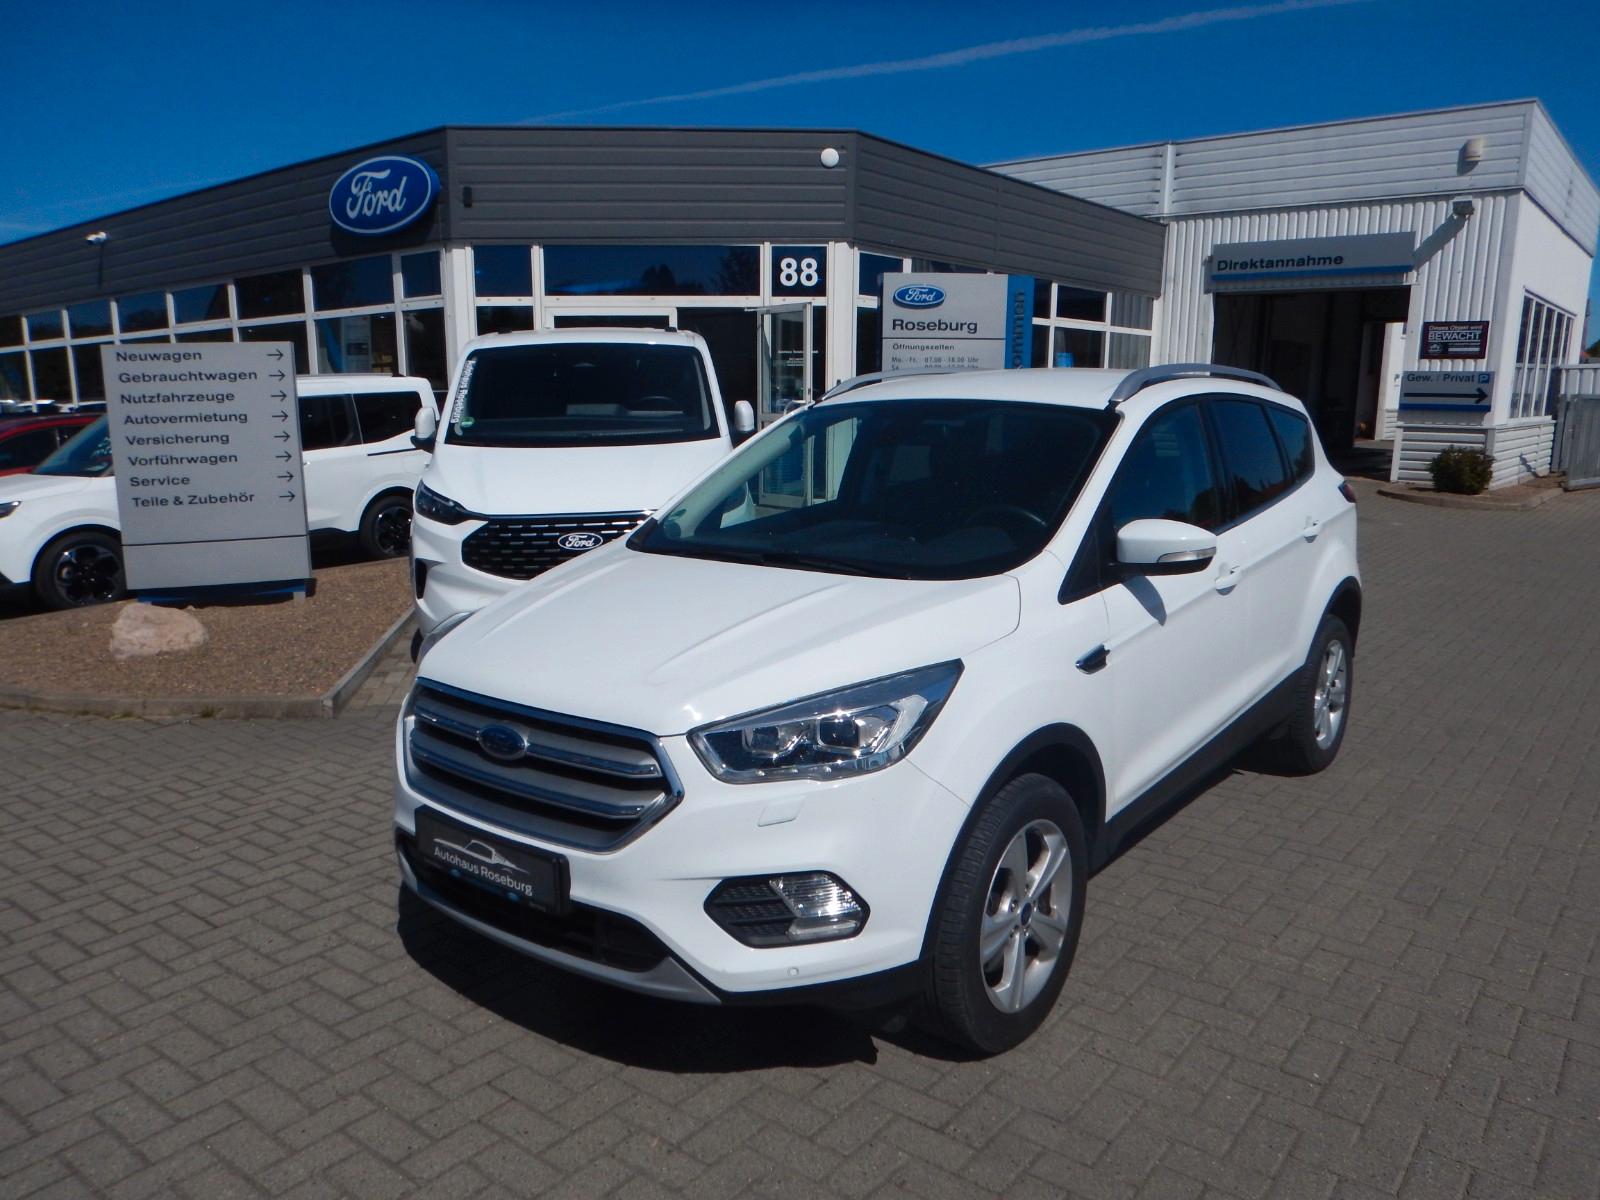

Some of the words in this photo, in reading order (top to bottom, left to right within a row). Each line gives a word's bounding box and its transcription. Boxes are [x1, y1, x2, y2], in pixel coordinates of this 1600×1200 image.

[346, 168, 407, 219] Ford
[1217, 255, 1344, 271] Direktannahme
[779, 257, 818, 287] 88
[905, 287, 935, 301] Ford
[892, 318, 978, 334] Roseburg
[1428, 332, 1480, 340] BEWACHT
[892, 342, 955, 352] Öffnungszeiten
[116, 350, 202, 363] Neuwagen
[118, 370, 258, 383] Gebrauchtwagen
[1442, 373, 1475, 382] Privat
[120, 391, 235, 404] Nutzfahrzeuge
[123, 412, 248, 425] Autovermietung
[126, 432, 230, 446] Versicherung
[128, 453, 238, 466] Vorführwagen
[130, 475, 191, 487] Service
[132, 497, 169, 508] Teile
[173, 495, 184, 506] &
[188, 492, 255, 505] Zubehör
[565, 535, 595, 547] Ford
[434, 847, 480, 875] Autohaus
[480, 866, 533, 897] Roseburg
